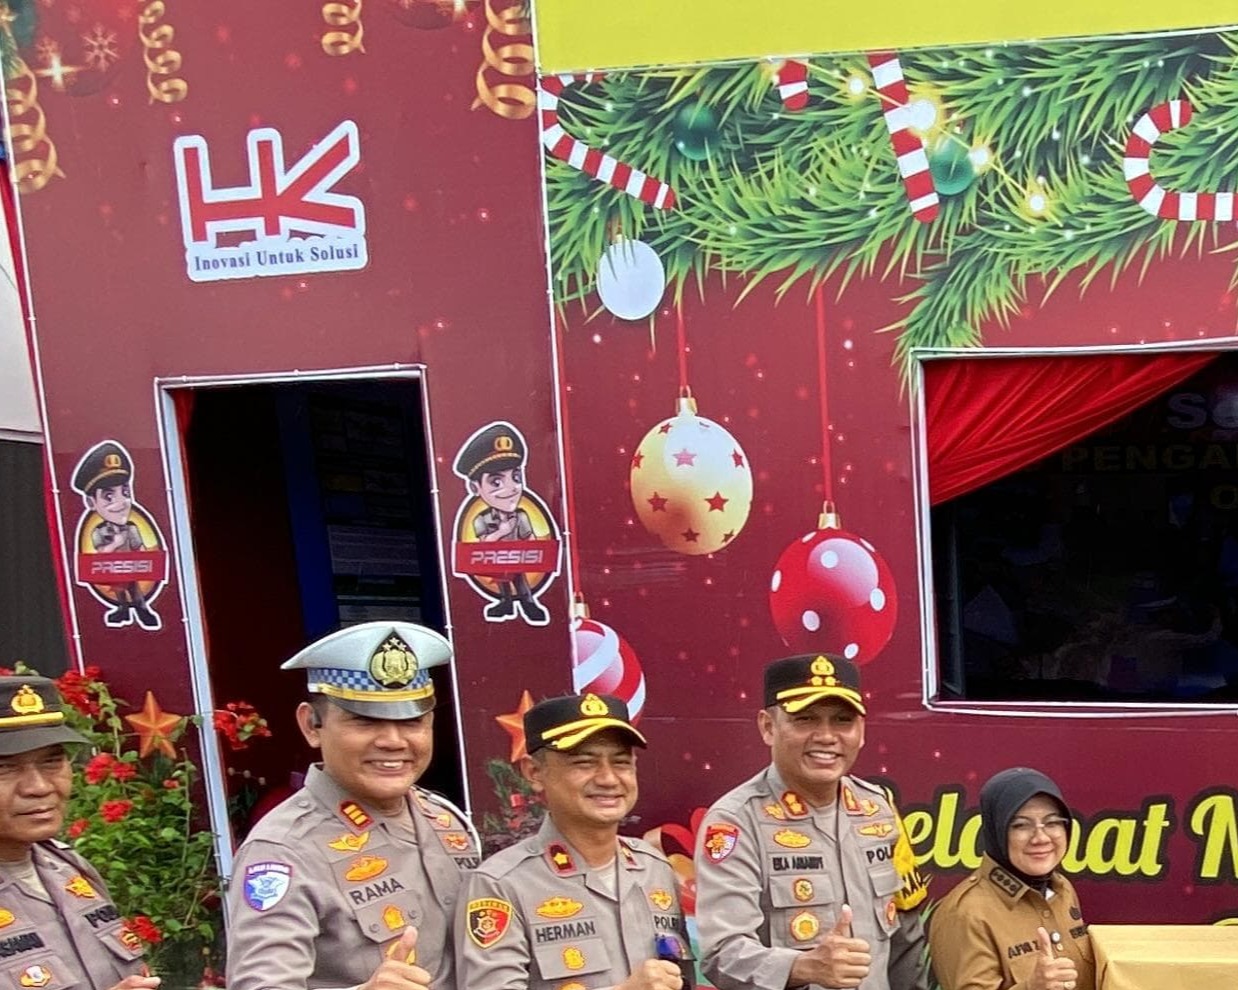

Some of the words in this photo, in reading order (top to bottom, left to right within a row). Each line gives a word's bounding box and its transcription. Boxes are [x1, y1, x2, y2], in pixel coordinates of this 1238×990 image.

[195, 253, 251, 272] Inovasi
[256, 249, 304, 266] Untuk
[310, 244, 359, 261] Solusi
[91, 560, 153, 574] PRESISI
[470, 549, 544, 565] PRESISI
[349, 877, 405, 906] RAMA
[534, 920, 596, 944] HERMAN
